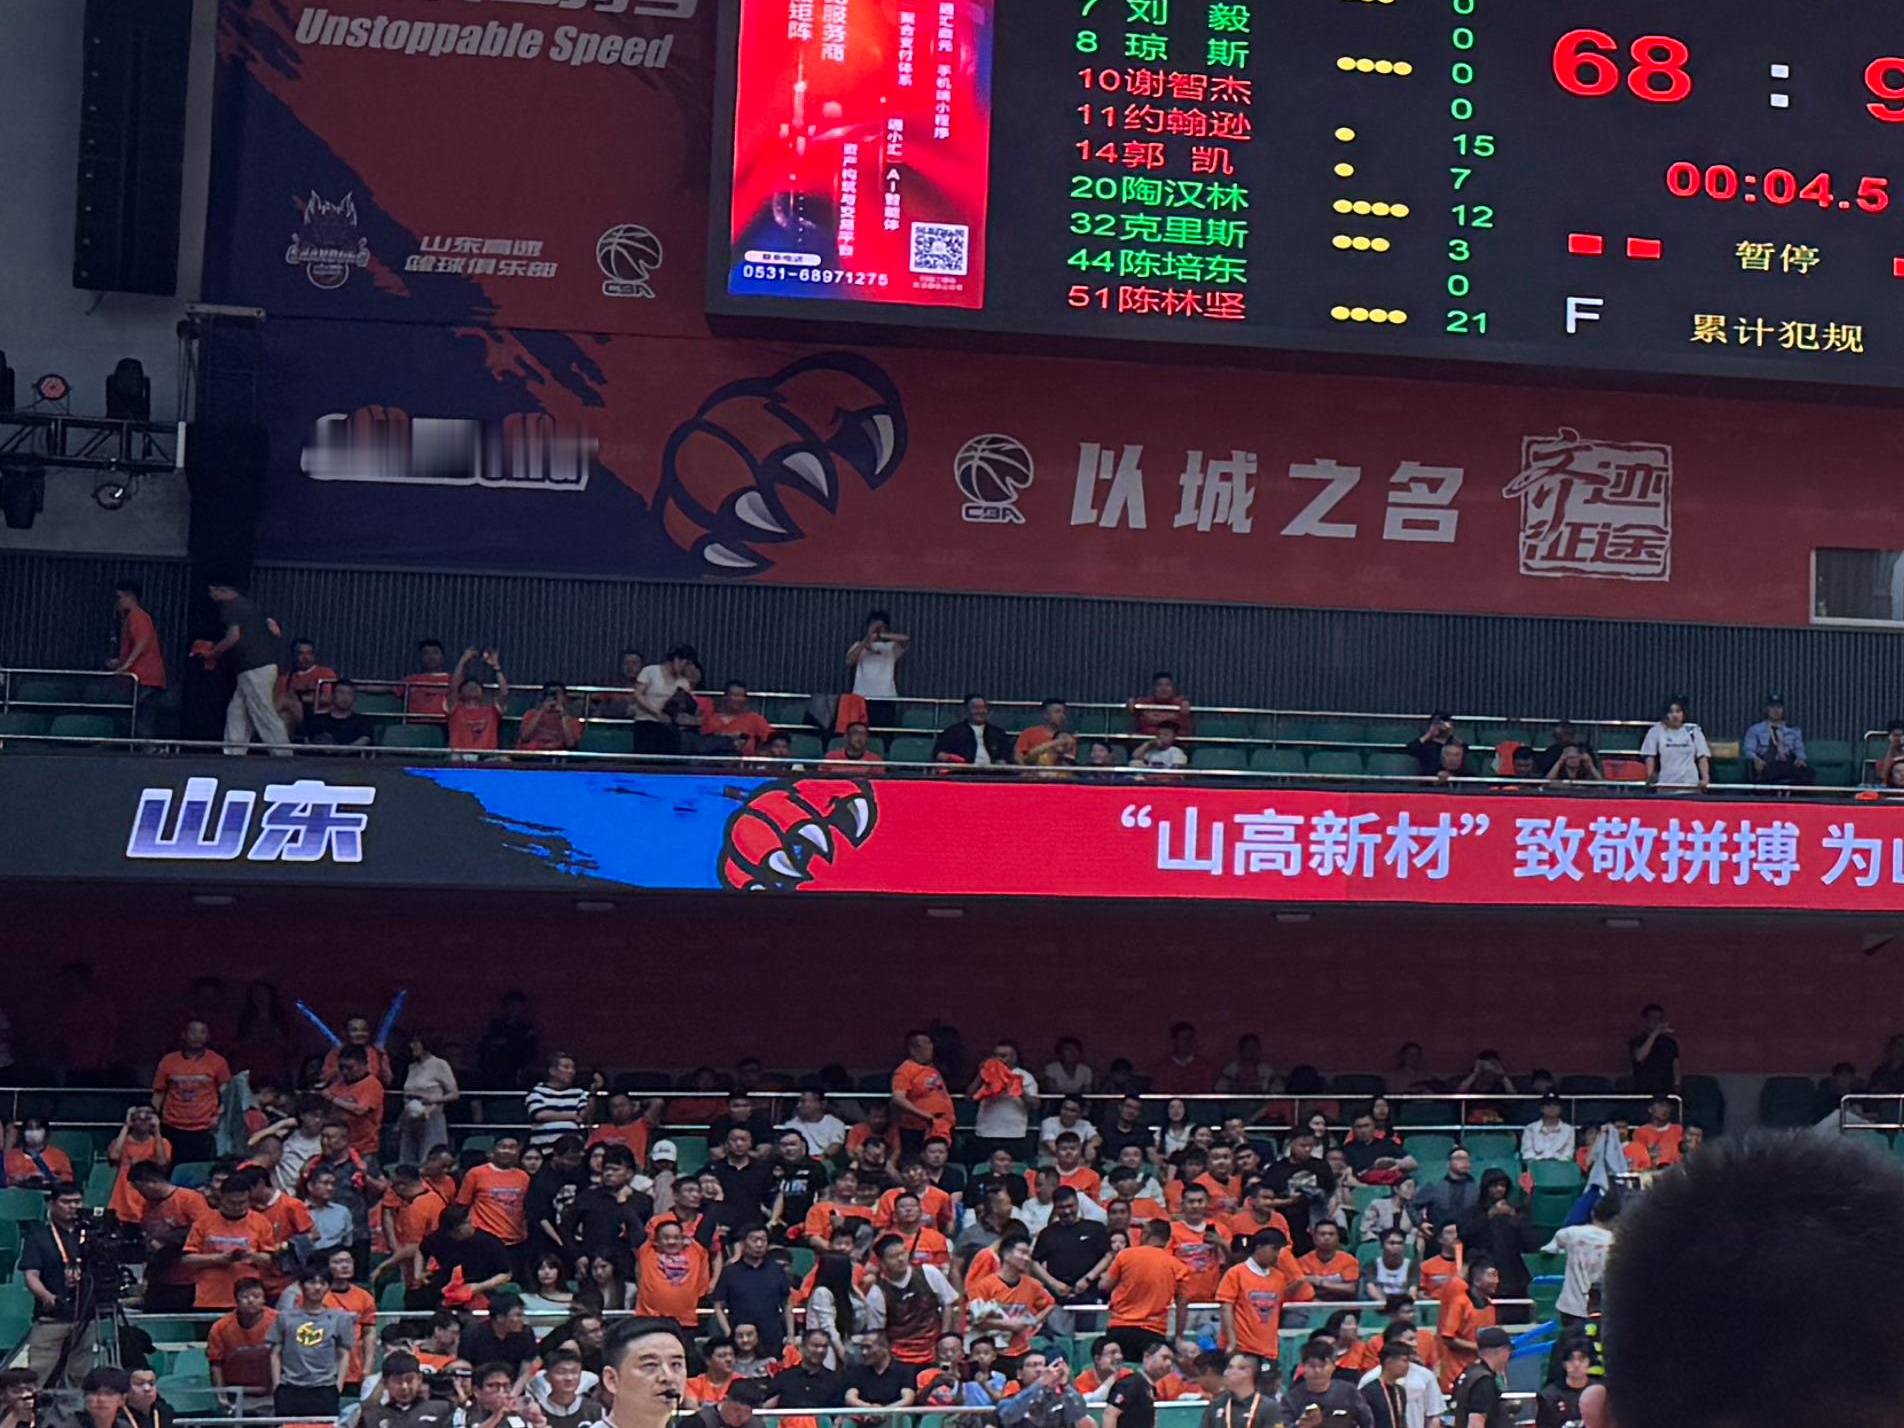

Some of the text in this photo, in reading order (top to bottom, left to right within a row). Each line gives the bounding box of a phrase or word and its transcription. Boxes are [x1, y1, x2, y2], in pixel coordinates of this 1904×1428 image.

[295, 6, 675, 70] Unstoppable Speed
[1075, 31, 1098, 53] 8
[1452, 63, 1474, 84] 0
[1453, 28, 1474, 50] 0
[1551, 29, 1692, 106] 68
[1079, 69, 1473, 120] 10 谢智杰 0
[1077, 104, 1495, 157] 11 约翰逊 15
[1075, 139, 1119, 163] 14
[1451, 168, 1472, 190] 7
[1666, 161, 1890, 214] 00:04.5
[1070, 176, 1494, 228] 20 陶汉林 12
[1069, 213, 1470, 261] 32 克里斯 3
[1734, 240, 1822, 278] 暂停
[742, 264, 889, 287] 0531-68971275
[1067, 249, 1470, 296] 44 陈培东 0
[1067, 285, 1487, 334] 51 陈林坚 21
[1564, 296, 1603, 335] F
[1688, 313, 1866, 357] 累计犯规
[1070, 440, 1467, 545] 以城之名
[126, 776, 378, 863] 山东
[1514, 814, 1802, 887] 致敬拼搏
